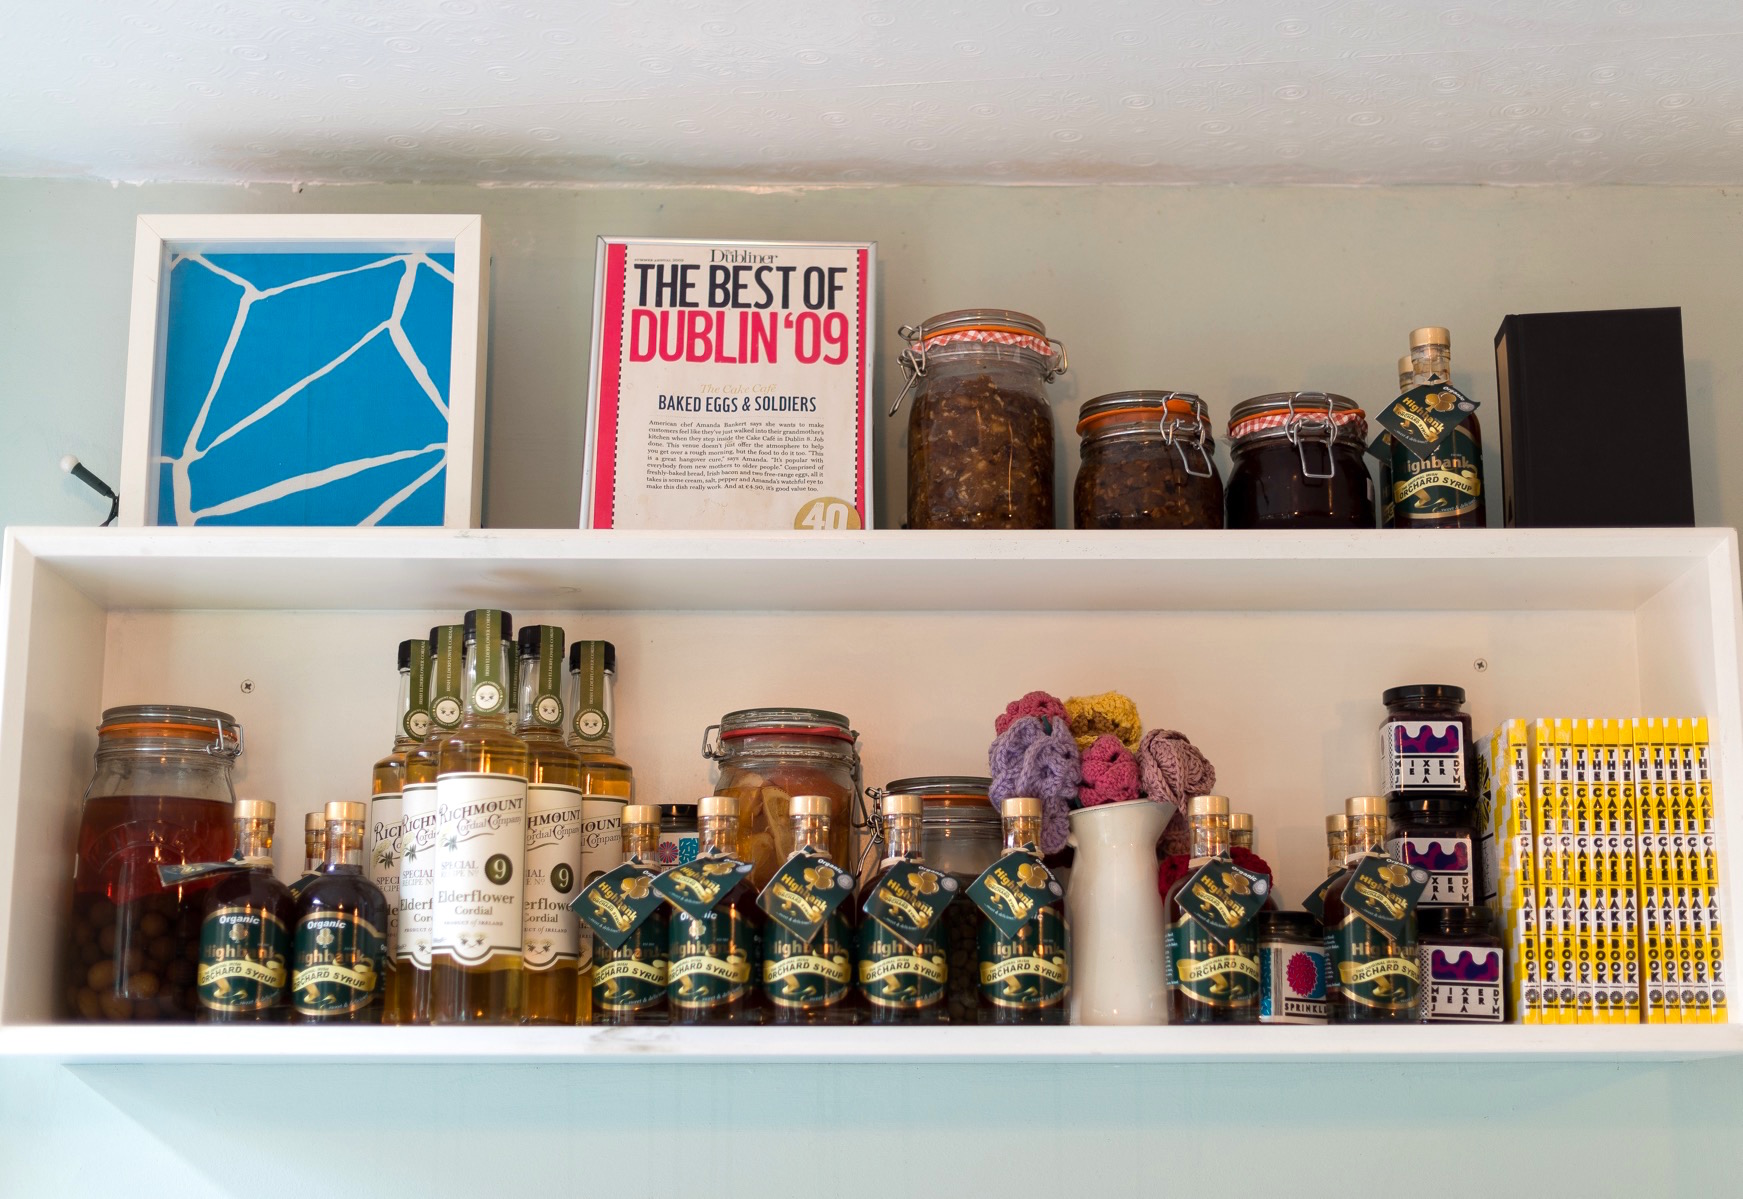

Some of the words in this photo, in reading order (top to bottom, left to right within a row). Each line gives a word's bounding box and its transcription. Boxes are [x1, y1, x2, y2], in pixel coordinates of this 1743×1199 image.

[634, 264, 700, 308] THE
[708, 265, 796, 309] BEST
[803, 266, 848, 310] OF
[629, 309, 778, 364] DUBLIN
[658, 394, 701, 412] BAKED
[706, 396, 738, 412] EGGS
[742, 396, 750, 412] &
[754, 396, 816, 412] SOLDIERS
[700, 384, 721, 394] The
[723, 384, 750, 394] Cake
[1402, 397, 1445, 432] Highbank
[1407, 456, 1469, 474] ighbank
[1400, 476, 1439, 498] ORCHARD
[1442, 477, 1472, 492] SYRUP
[802, 502, 848, 529] 40
[1577, 749, 1586, 781] THE
[1607, 749, 1616, 781] THE
[1654, 748, 1663, 780] THE
[1669, 748, 1678, 780] THE
[1683, 748, 1692, 780] THE
[439, 798, 523, 825] RICHMOUNT
[1577, 787, 1588, 831] CAKE
[1607, 787, 1619, 831] CAKE
[1655, 787, 1667, 830] CAKE
[1670, 787, 1682, 830] CAKE
[1684, 787, 1696, 831] CAKE
[457, 819, 486, 836] Cordial
[488, 814, 522, 830] Company
[494, 859, 506, 879] 9
[560, 869, 569, 888] 9
[818, 859, 843, 874] Organic
[1232, 866, 1257, 882] Organic
[1386, 858, 1415, 869] Organic
[438, 890, 515, 904] Elderflower
[599, 881, 637, 921] Highbank
[781, 874, 828, 912] Highbank
[887, 878, 934, 917] Highbank
[994, 867, 1034, 909] Highbank
[1201, 874, 1246, 917] Highbank
[1360, 874, 1408, 909] Highbank
[219, 916, 260, 924] Organic
[307, 920, 346, 929] Organic
[455, 906, 492, 915] Cordial
[1578, 888, 1589, 932] BAKE
[1609, 888, 1620, 932] BAKE
[1662, 887, 1673, 931] BAKE
[1677, 887, 1688, 931] BAKE
[1691, 887, 1703, 932] BAKE
[202, 966, 241, 983] ORCHARD
[245, 968, 276, 984] SYRUP
[632, 968, 664, 982] SYRUP
[669, 963, 702, 981] ORCHARD
[706, 964, 739, 979] SYRUP
[767, 962, 809, 980] ORCHARD
[813, 963, 843, 979] SYRUP
[866, 961, 910, 980] ORCHARD
[913, 963, 941, 979] SYRUP
[987, 963, 1030, 982] ORCHARD
[1034, 964, 1061, 979] SYRUP
[1190, 961, 1236, 979] ORCHARD
[1352, 964, 1399, 981] ORCHARD
[1579, 939, 1590, 984] BOOK
[1610, 939, 1622, 984] BOOK
[1664, 938, 1677, 983] BOOK
[1680, 938, 1693, 983] BOOK
[1694, 938, 1707, 983] BOOK
[333, 973, 365, 988] SYRUP
[1431, 987, 1499, 997] MIXED
[1431, 996, 1499, 1005] BERRY
[1431, 1004, 1500, 1014] JAM
